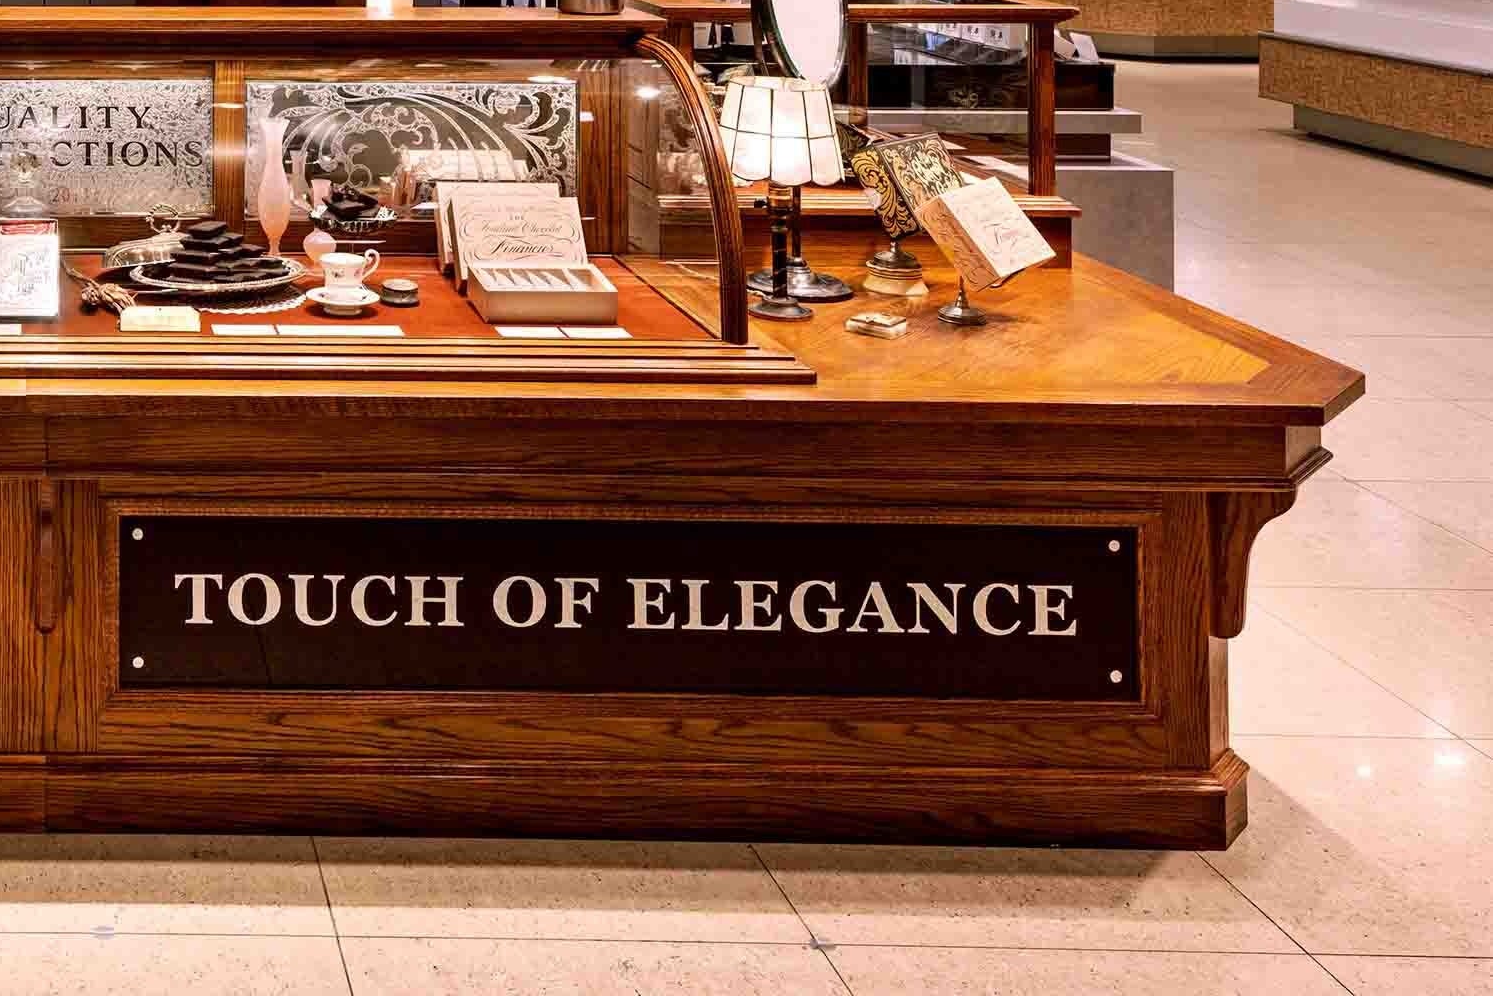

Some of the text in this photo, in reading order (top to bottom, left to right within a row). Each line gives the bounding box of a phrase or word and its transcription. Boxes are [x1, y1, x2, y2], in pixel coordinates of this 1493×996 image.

[174, 573, 1077, 636] TOUCH OF ELEGANCE
